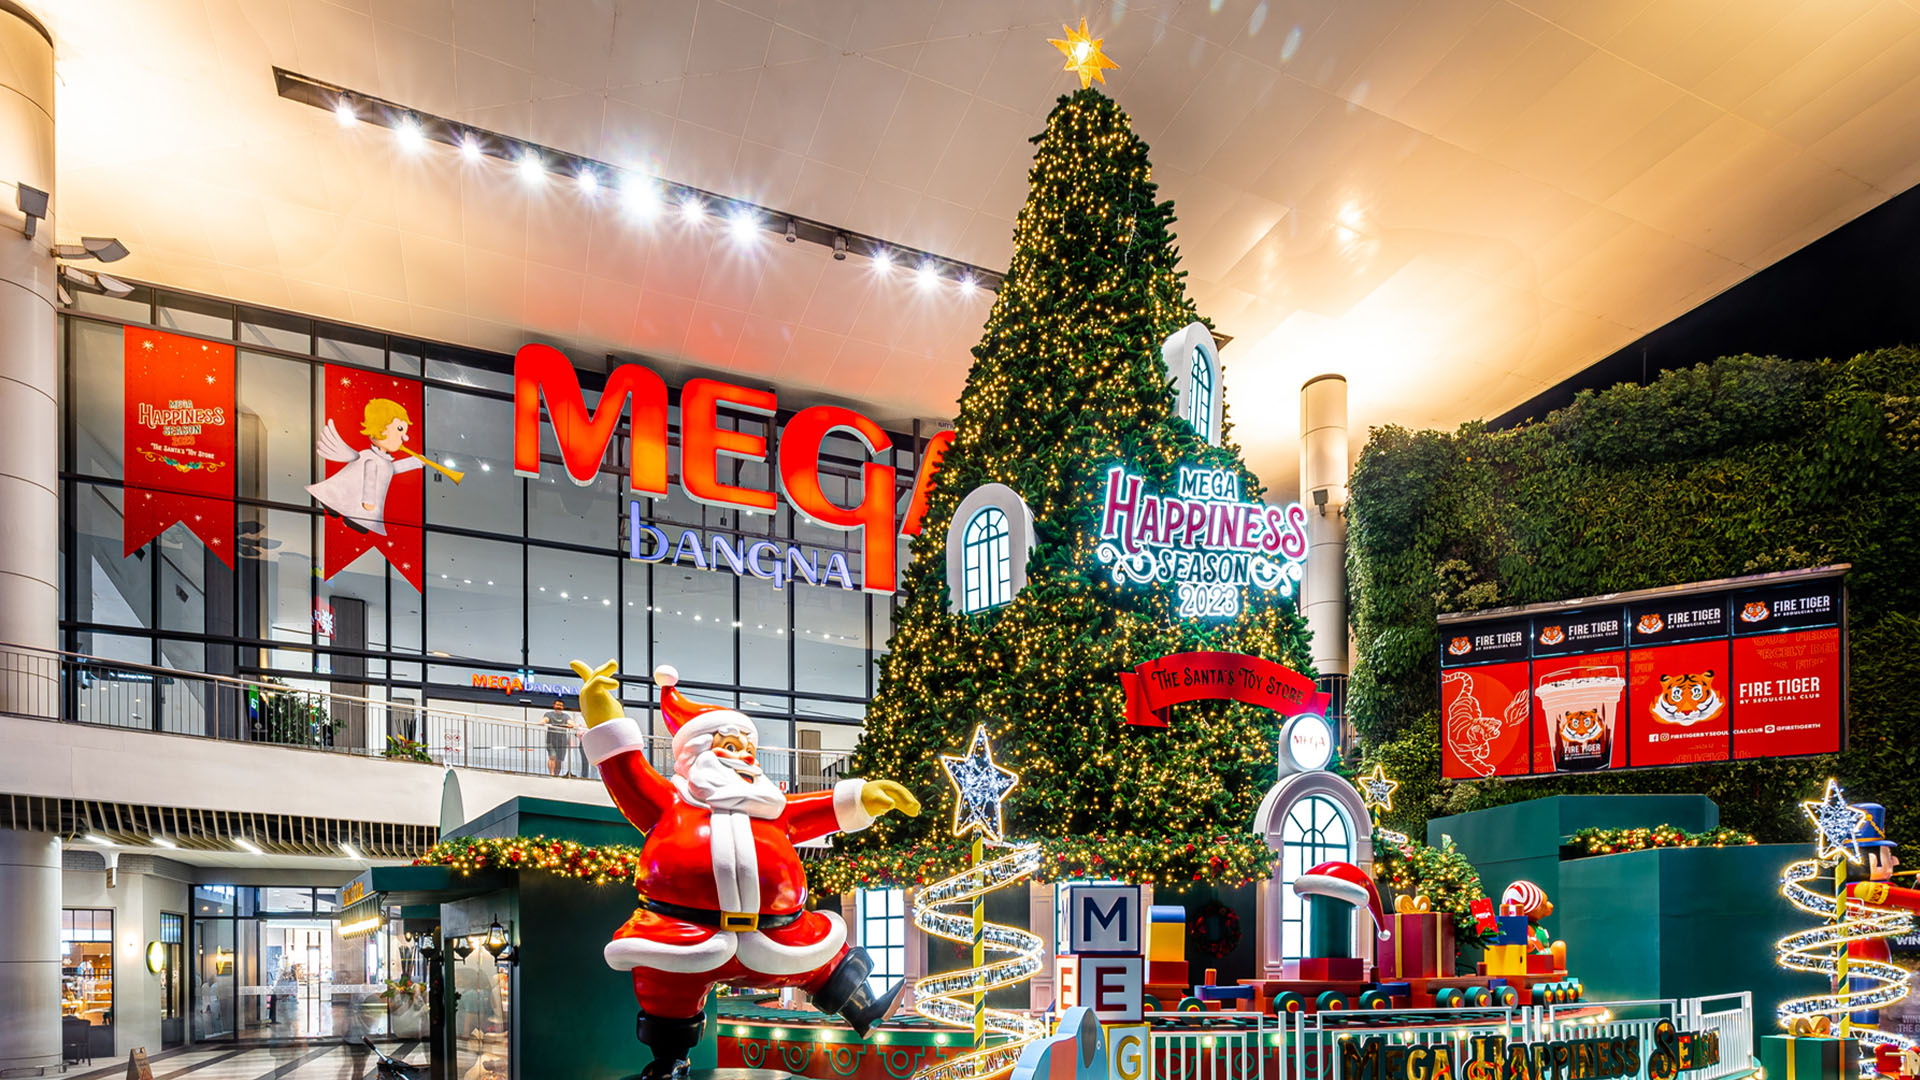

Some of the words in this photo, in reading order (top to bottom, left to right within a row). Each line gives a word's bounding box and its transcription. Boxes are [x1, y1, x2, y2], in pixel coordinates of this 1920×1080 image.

[138, 402, 225, 429] HAPPINESS
[169, 400, 193, 409] MEGA
[163, 425, 202, 436] SEASON
[1178, 467, 1239, 502] MEGA
[1101, 467, 1308, 562] HAPPINESS
[1157, 549, 1252, 585] SEASON
[1179, 585, 1239, 617] 2023
[1773, 599, 1797, 613] FIRE
[1799, 595, 1830, 610] TIGER
[1568, 623, 1589, 636] FIRE
[1590, 620, 1618, 634] TIGER
[1667, 611, 1689, 624] FIRE
[1691, 607, 1721, 622] TIGER
[1475, 634, 1495, 647] FIRE
[1496, 631, 1522, 644] TIGER
[472, 673, 524, 696] MEGA
[1151, 669, 1180, 690] THE
[1184, 667, 1234, 686] SANTA'S
[1238, 667, 1264, 693] TOY
[1266, 677, 1305, 706] STORE
[1739, 680, 1772, 698] FIRE
[1776, 676, 1821, 695] TIGER
[1753, 695, 1797, 704] SEOULCIAL
[1083, 896, 1127, 942] M
[1061, 967, 1073, 1010] E
[1095, 966, 1127, 1012] E
[1116, 1035, 1142, 1080] G
